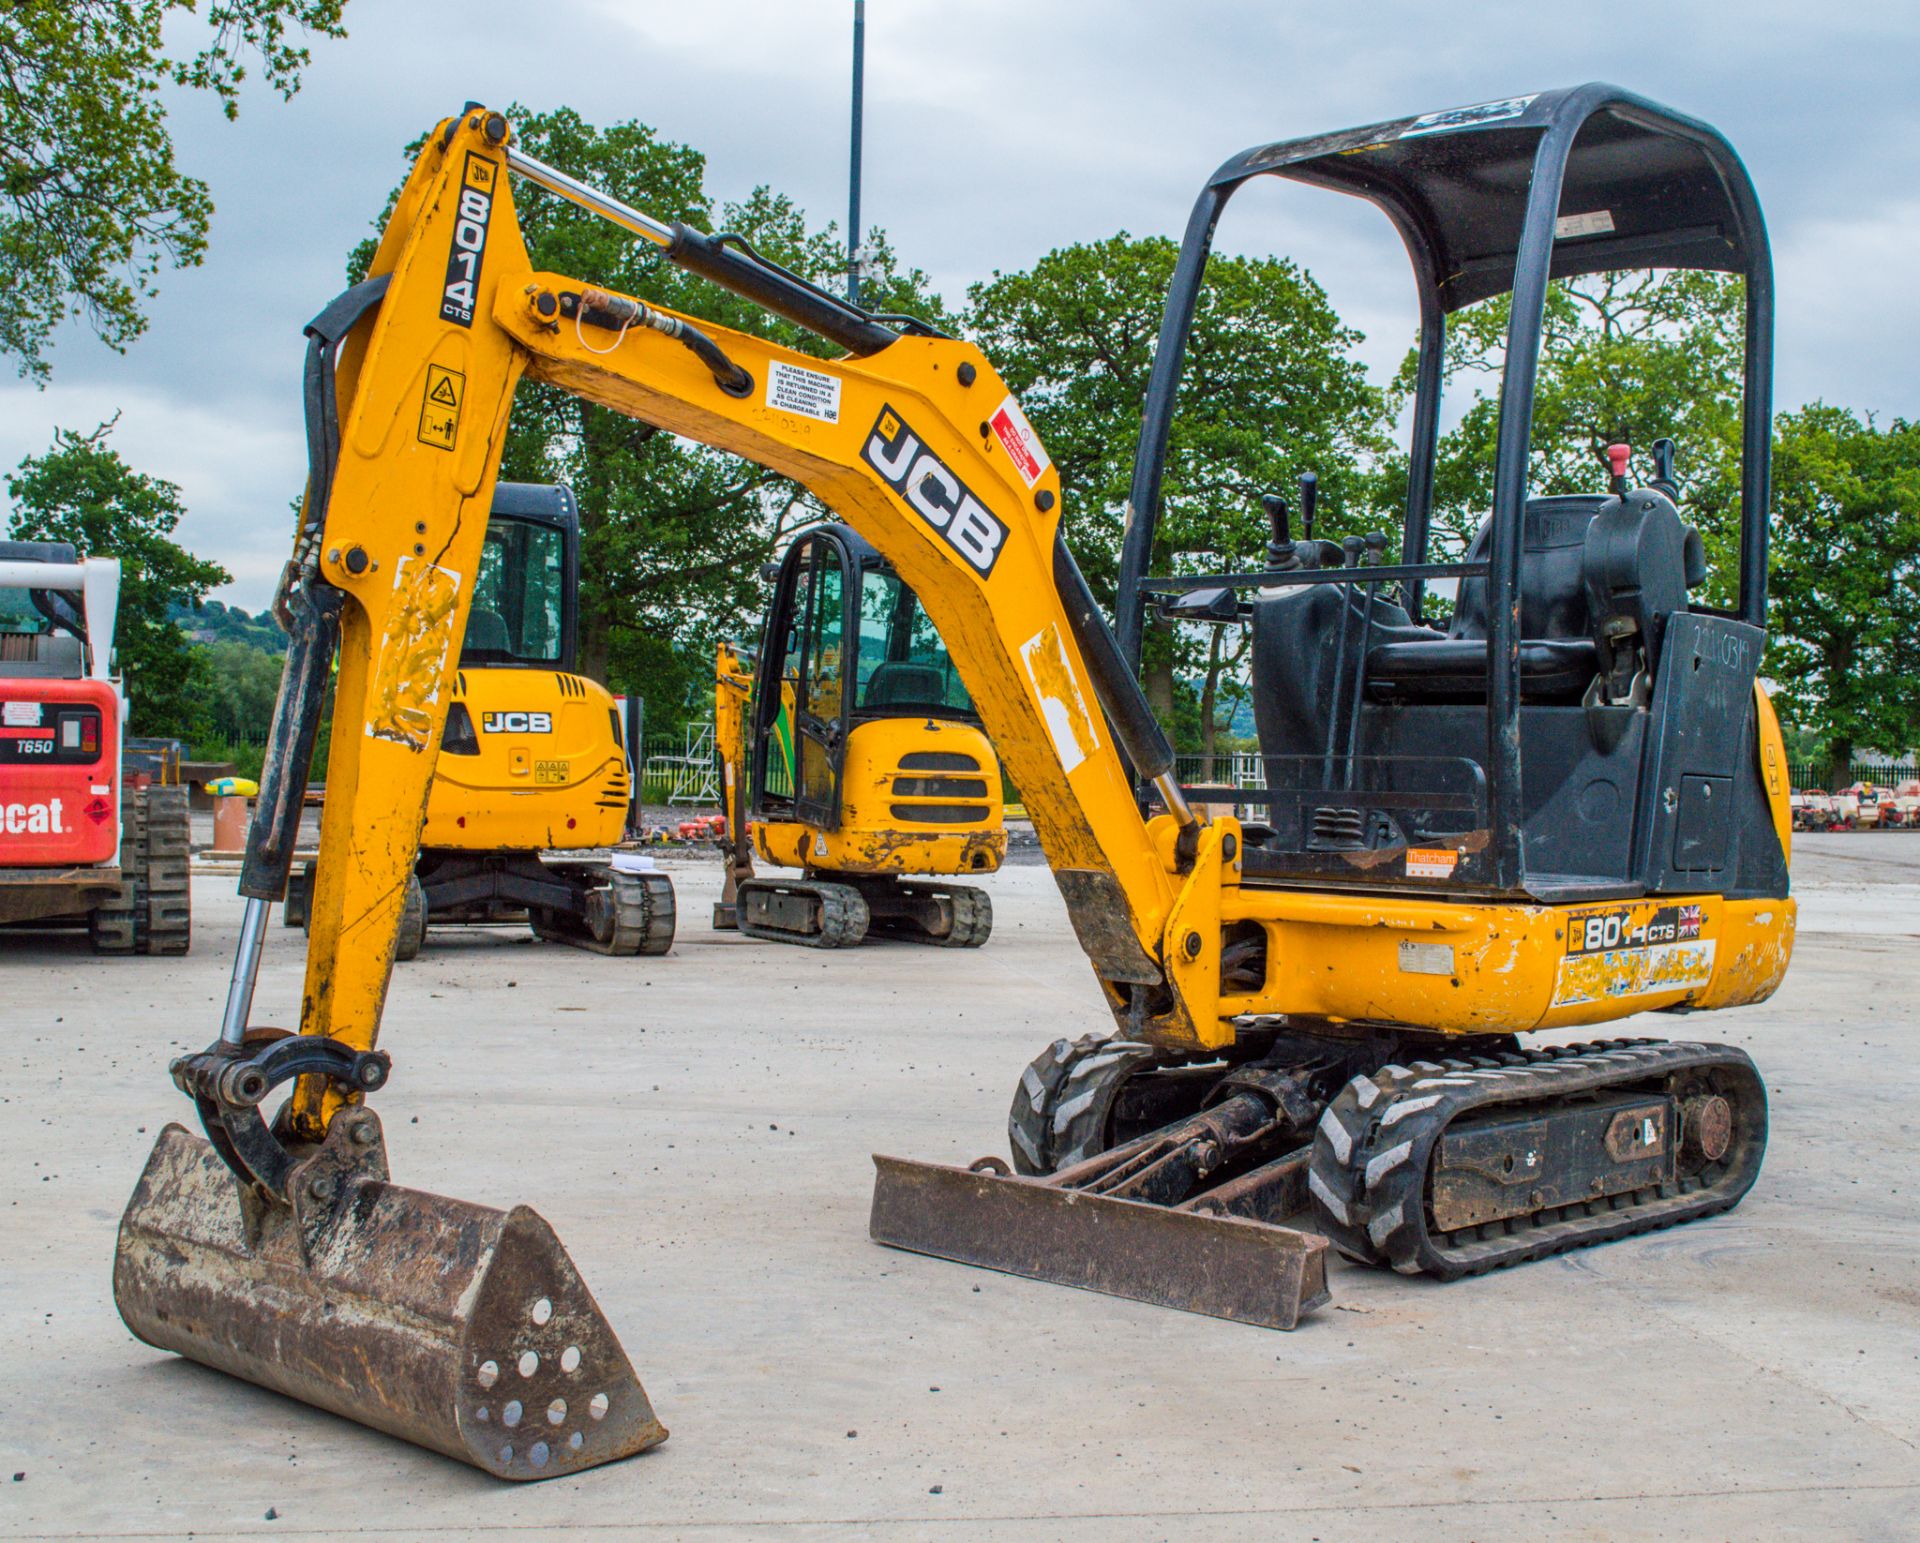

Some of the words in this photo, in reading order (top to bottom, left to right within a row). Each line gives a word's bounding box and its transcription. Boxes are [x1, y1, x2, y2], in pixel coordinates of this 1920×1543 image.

[445, 189, 491, 310] 8014
[443, 303, 472, 321] CTS
[776, 371, 791, 380] THAT
[793, 375, 806, 384] THIS
[808, 380, 834, 391] MACHINE
[781, 365, 805, 377] PLEASE
[806, 372, 830, 383] ENSURE
[776, 386, 797, 396] CLEAN
[798, 391, 832, 405] CONDITION
[786, 381, 818, 394] RETURNED
[780, 401, 820, 416] CHARGEABLE
[786, 395, 817, 408] CLEANING
[868, 434, 1002, 570] JCB
[484, 712, 551, 732] JCB
[17, 740, 53, 754] T650
[0, 798, 63, 834] cat
[1408, 850, 1455, 864] Thatcham
[1648, 924, 1675, 941] CTS
